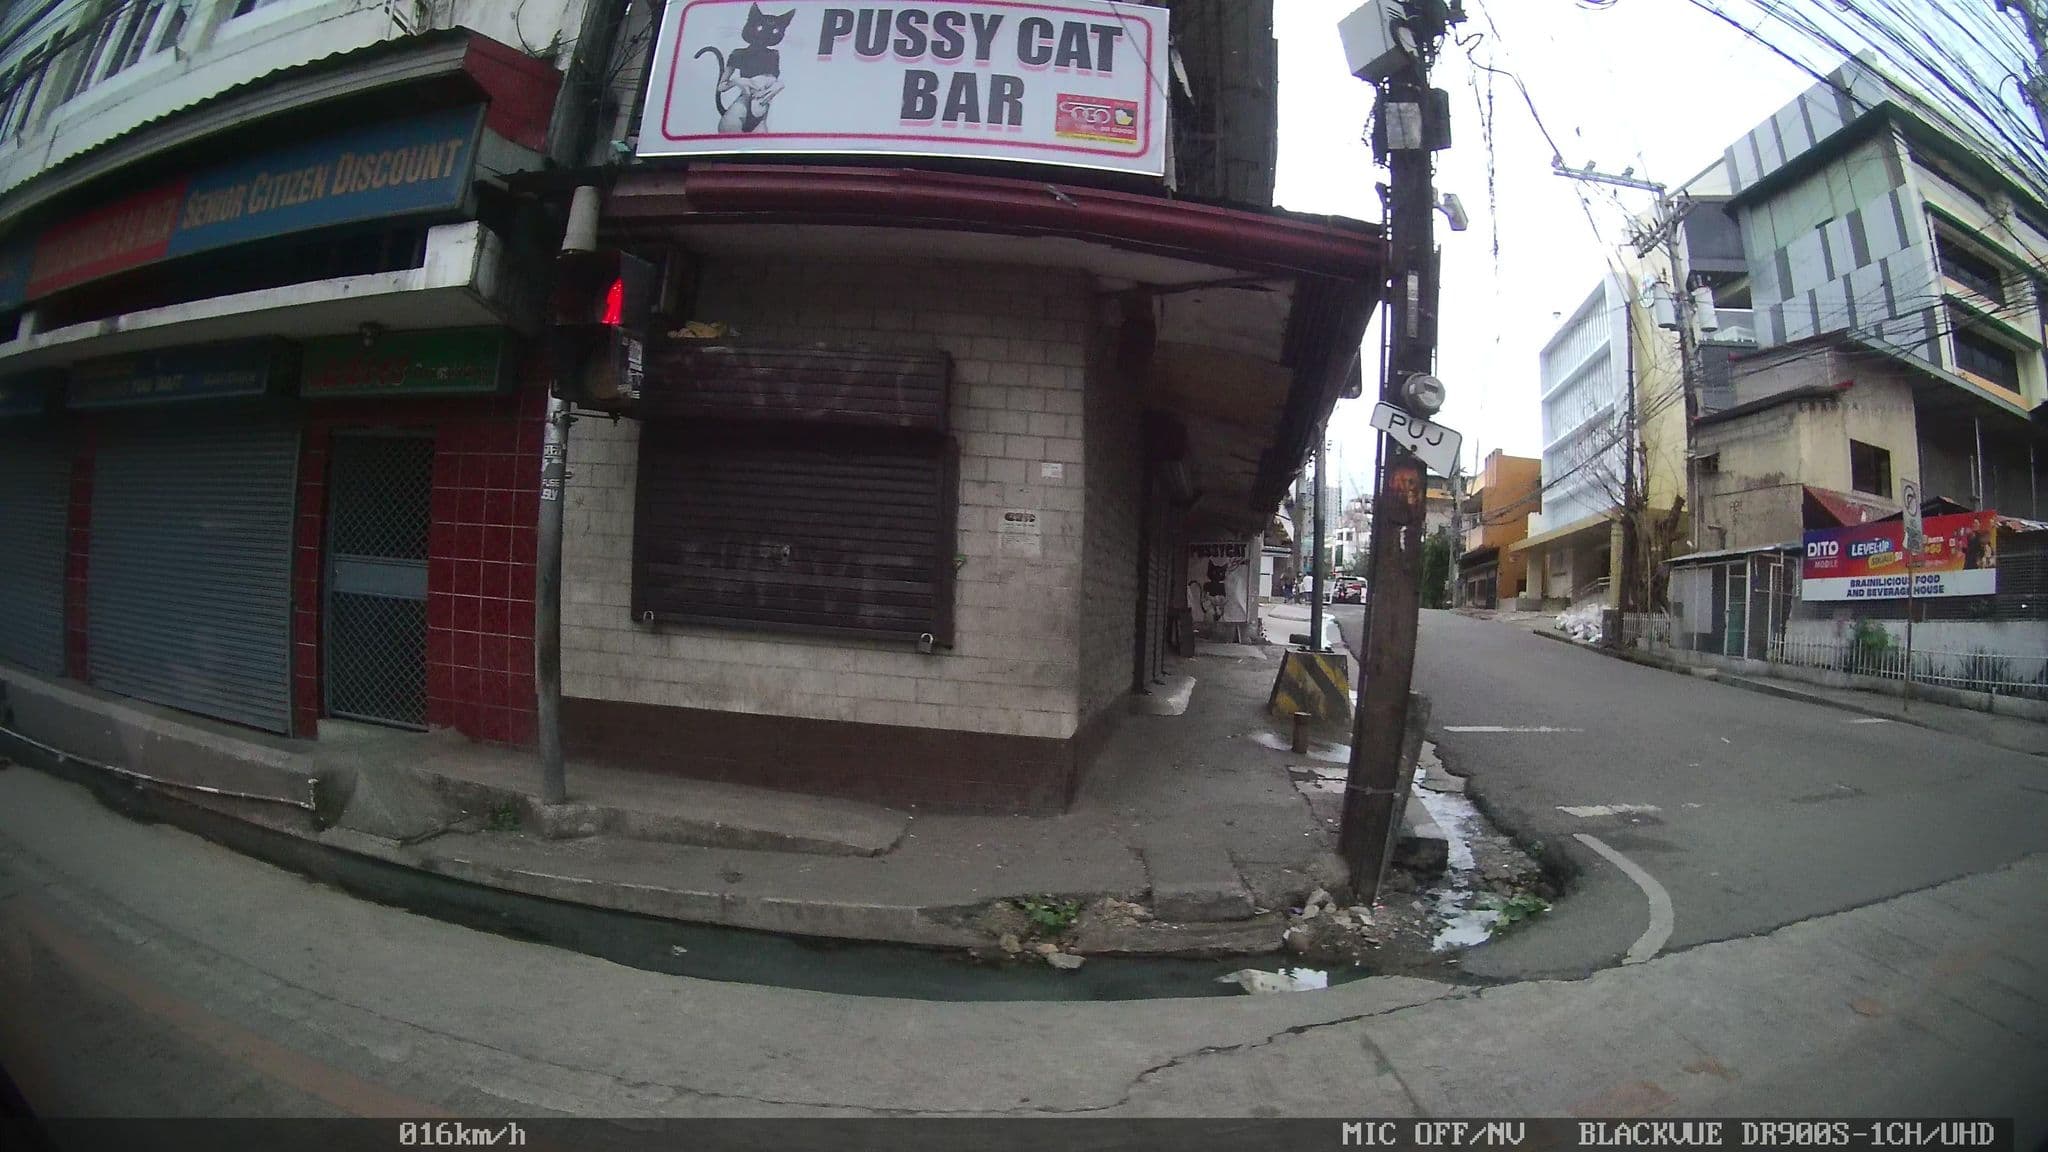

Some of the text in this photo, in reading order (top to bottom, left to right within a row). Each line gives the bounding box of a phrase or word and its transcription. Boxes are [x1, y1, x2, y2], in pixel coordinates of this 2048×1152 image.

[818, 9, 1123, 72] PUSSY CAT
[900, 70, 1024, 126] BAR
[181, 138, 463, 229] SENIOR CITIZEN DISCOUNT
[1388, 413, 1444, 446] PUJ
[1807, 541, 1839, 557] DITO
[1846, 589, 1865, 597] AND
[1913, 585, 1945, 595] HOUSE
[1915, 574, 1940, 584] FOOD
